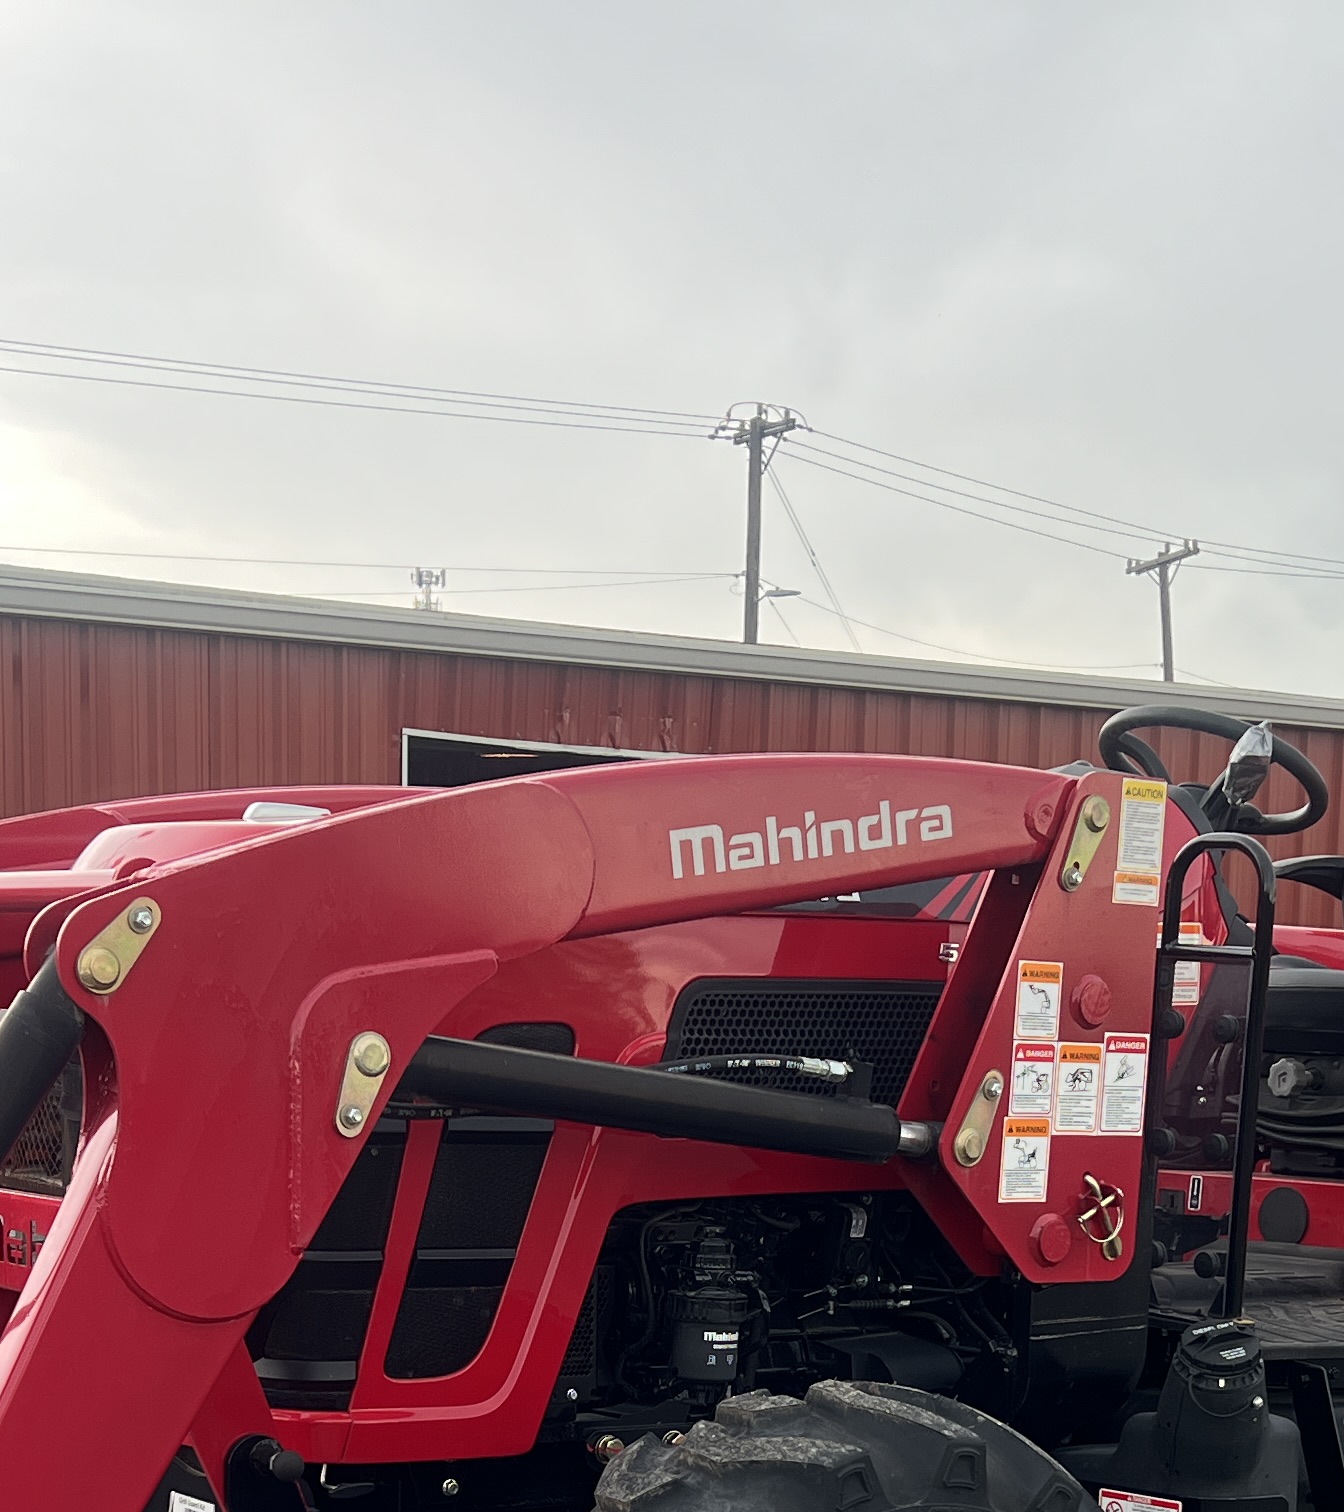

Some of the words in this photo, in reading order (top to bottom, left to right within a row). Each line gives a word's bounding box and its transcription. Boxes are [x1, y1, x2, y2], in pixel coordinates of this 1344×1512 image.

[1132, 786, 1164, 799] CAUTION
[668, 799, 953, 880] Mahindra
[1028, 970, 1060, 979] WARNING
[1115, 1041, 1146, 1050] DANGER
[1025, 1049, 1054, 1058] DANGER
[1068, 1052, 1100, 1061] WARNING
[1014, 1125, 1048, 1134] WARNING
